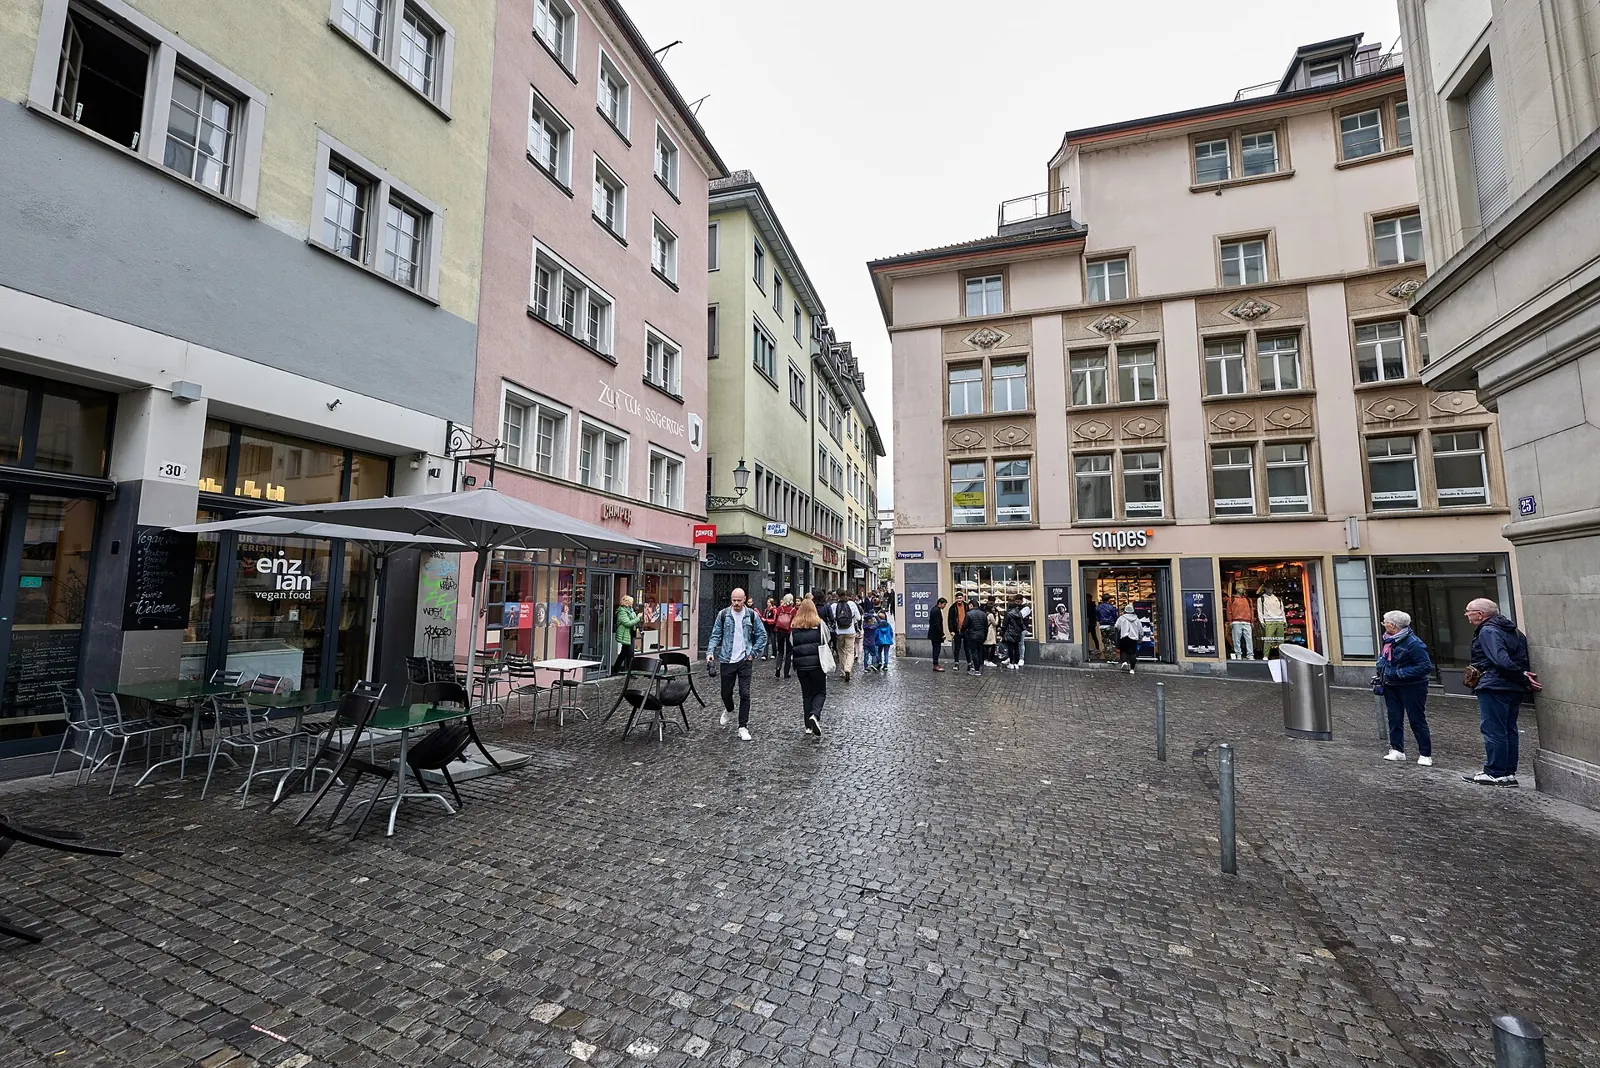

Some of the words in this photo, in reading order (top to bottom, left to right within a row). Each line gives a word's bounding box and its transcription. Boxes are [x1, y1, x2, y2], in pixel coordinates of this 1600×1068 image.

[165, 463, 181, 477] 30
[602, 502, 633, 525] CAMPER
[1521, 499, 1532, 513] 25
[137, 528, 164, 551] Vegan
[695, 529, 714, 538] CAMPER
[1092, 529, 1147, 551] snipes
[256, 551, 302, 574] enz
[255, 591, 286, 601] vegan
[288, 590, 311, 600] food
[130, 599, 181, 614] Welcome
